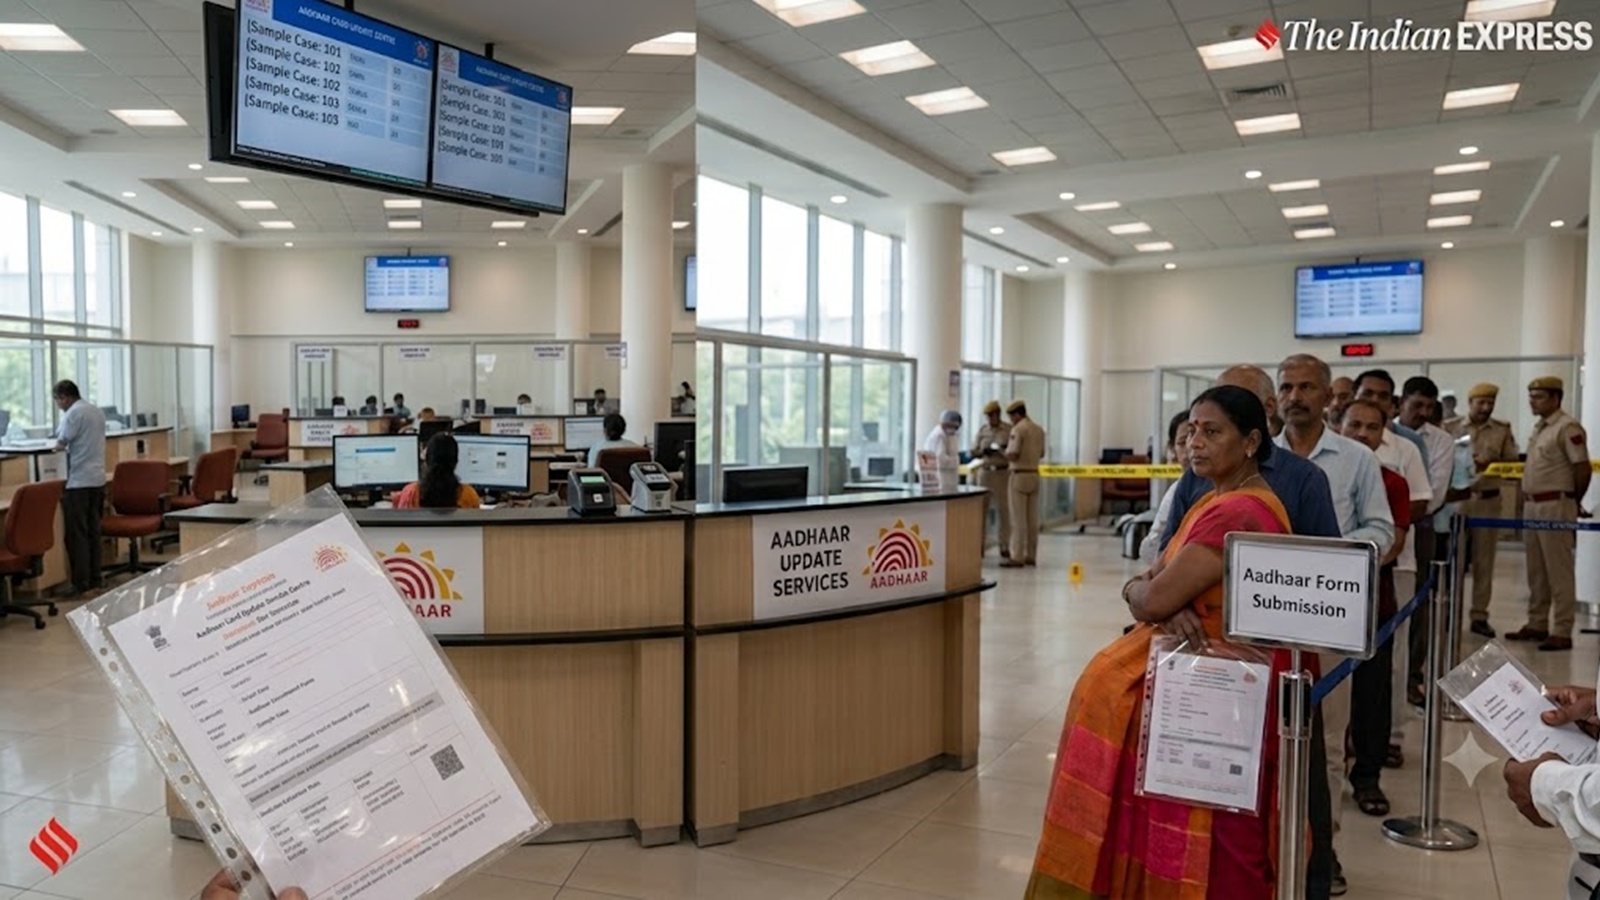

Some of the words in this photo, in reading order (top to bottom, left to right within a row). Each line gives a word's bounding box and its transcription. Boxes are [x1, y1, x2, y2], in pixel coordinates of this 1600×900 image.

[294, 34, 321, 52] Case:
[325, 43, 342, 58] 101
[293, 51, 321, 69] Case:
[323, 60, 340, 75] 102
[293, 69, 320, 87] Case:
[323, 78, 341, 92] 102
[292, 87, 319, 103] Case:
[322, 95, 340, 109] 103
[291, 105, 319, 121] Case:
[322, 112, 339, 126] 103
[771, 525, 850, 549] AADHAAR
[780, 549, 842, 572] UPDATE
[773, 571, 849, 597] SERVICES
[870, 571, 928, 589] AADHAAR
[1243, 567, 1311, 588] Aadhaar
[1316, 575, 1360, 593] Form
[1252, 593, 1346, 618] Submission
